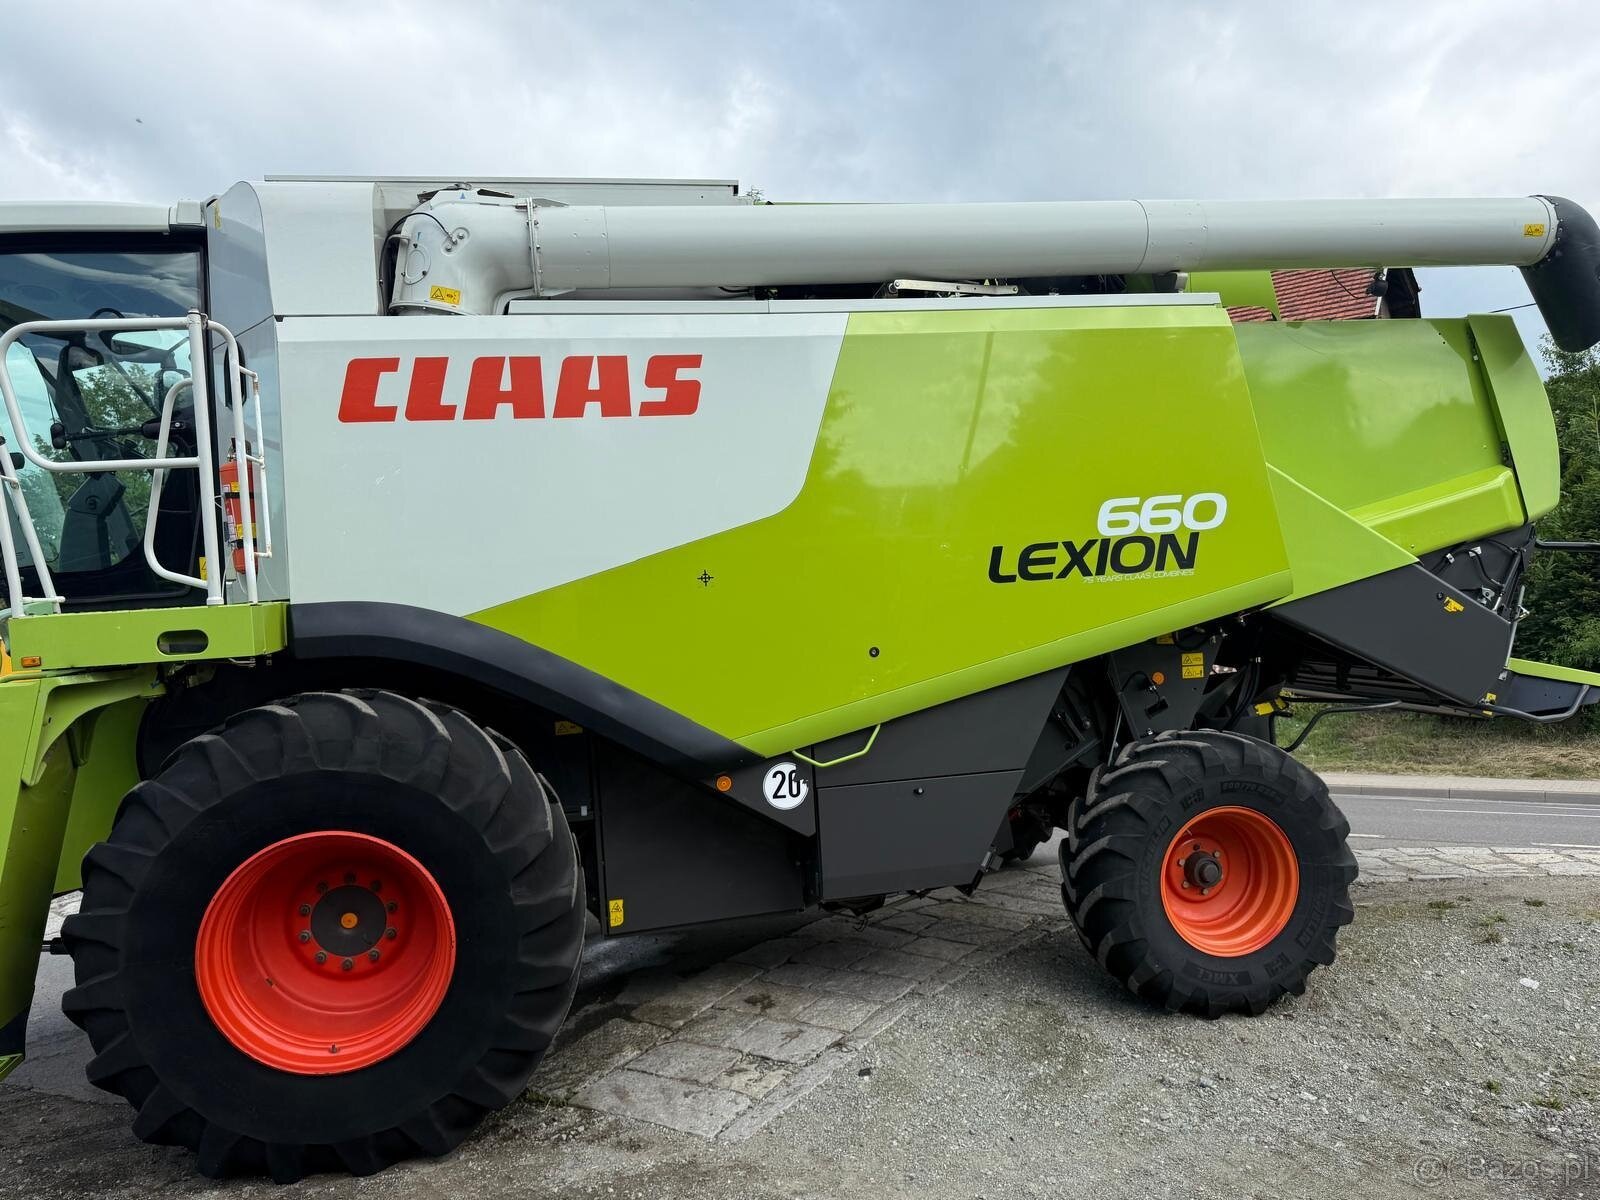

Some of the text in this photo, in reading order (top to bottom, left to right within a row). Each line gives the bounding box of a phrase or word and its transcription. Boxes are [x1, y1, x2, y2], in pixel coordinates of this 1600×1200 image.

[338, 354, 702, 423] CLAAS
[1097, 493, 1227, 536] 660
[988, 532, 1199, 583] LEXION
